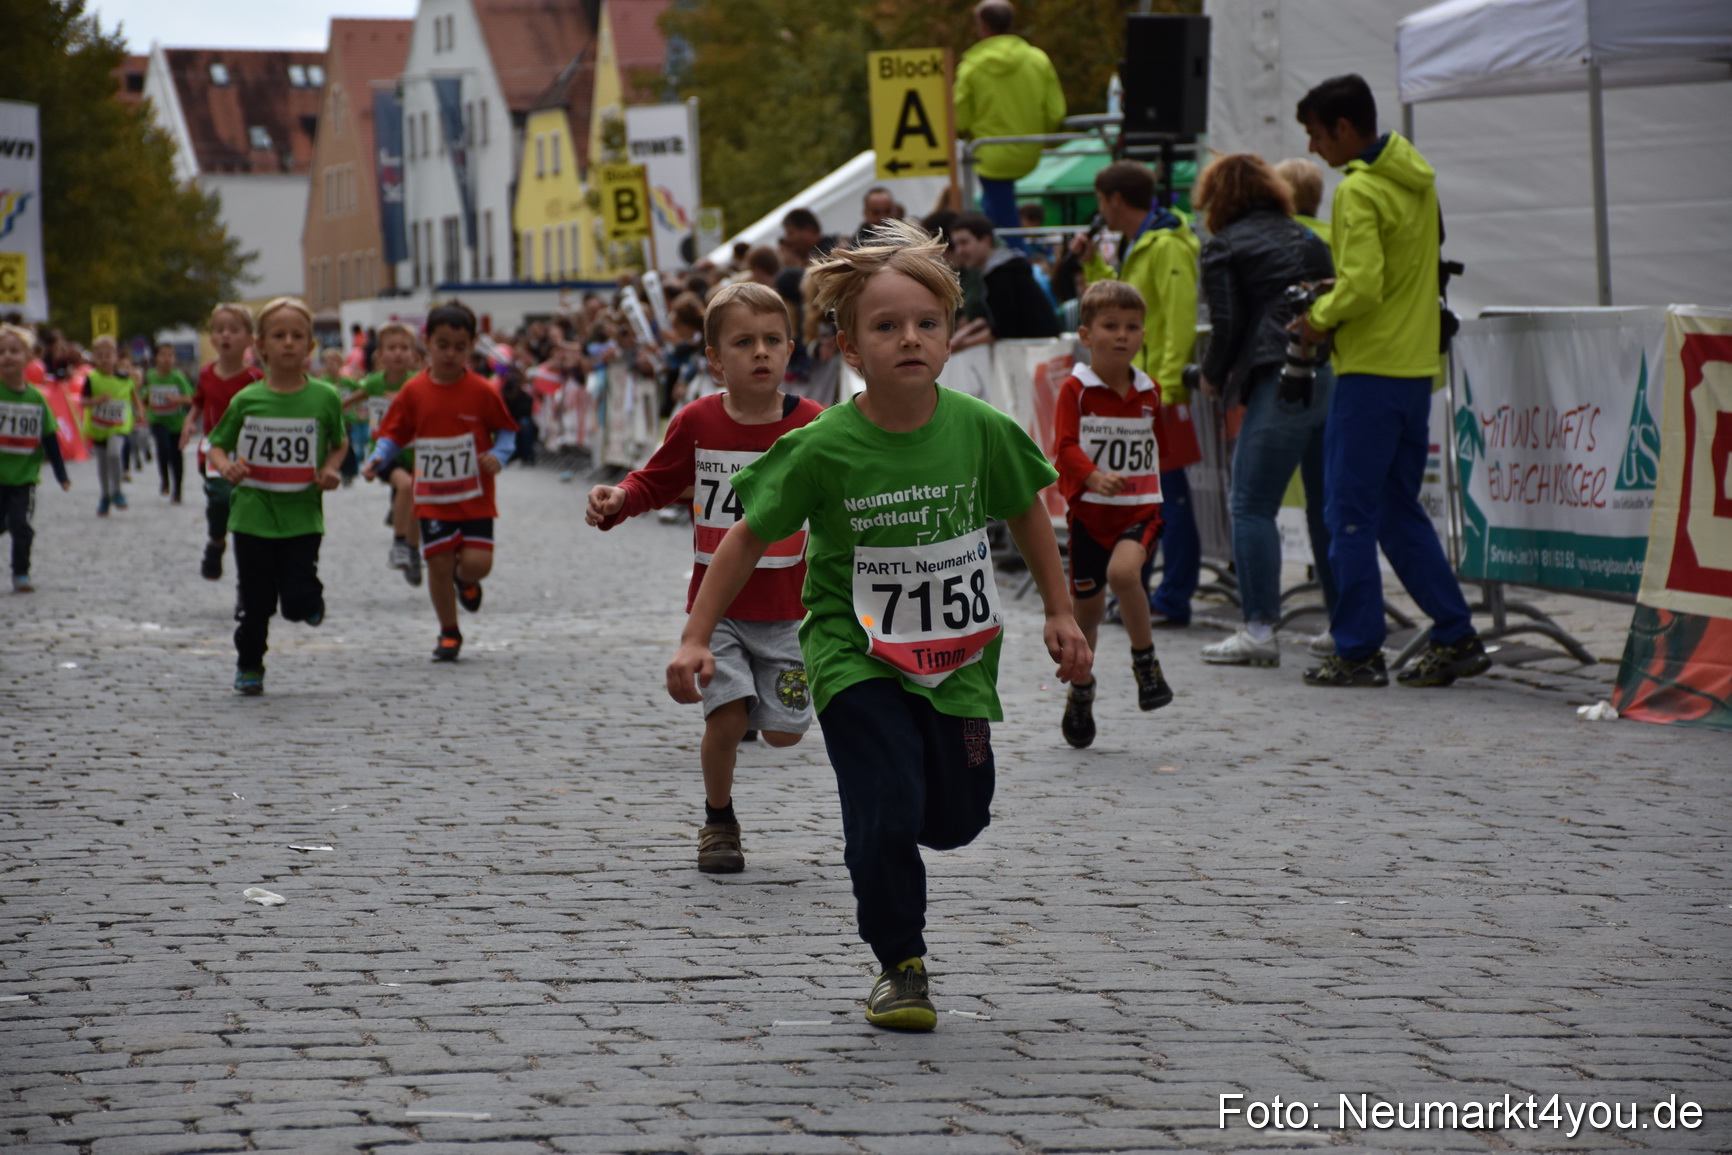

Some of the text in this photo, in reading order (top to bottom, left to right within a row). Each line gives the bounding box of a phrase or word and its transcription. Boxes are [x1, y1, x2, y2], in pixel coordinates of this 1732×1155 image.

[880, 56, 943, 79] Block
[892, 88, 939, 150] A
[614, 188, 640, 223] B
[1082, 425, 1114, 435] PARTL
[244, 434, 309, 463] 7439
[1090, 438, 1155, 472] 7058
[420, 451, 471, 479] 7217
[696, 460, 728, 474] PARTL
[843, 484, 949, 513] Neumarkter
[849, 505, 930, 533] Stadtlauf
[856, 550, 977, 575] PARTL Neumarkt
[871, 568, 991, 635] 7158
[911, 646, 966, 670] Timm
